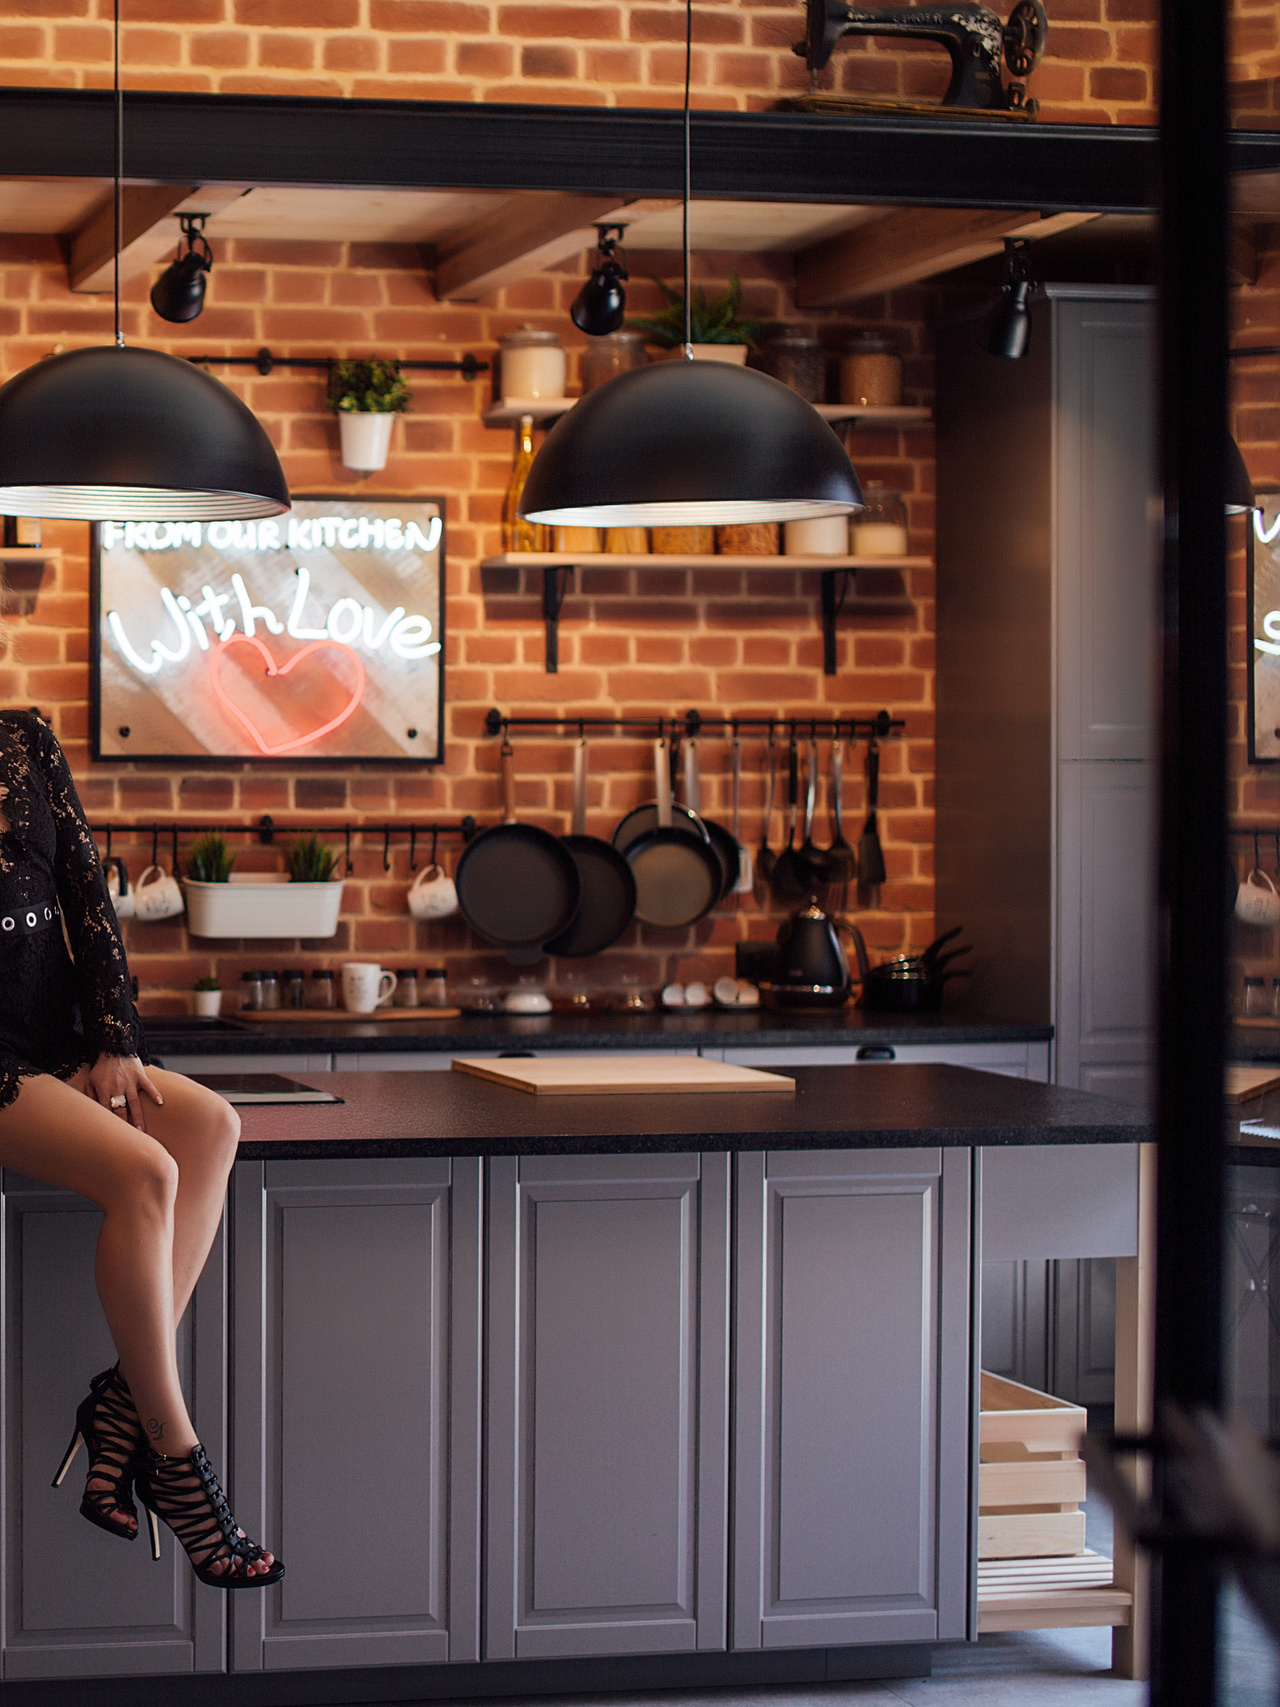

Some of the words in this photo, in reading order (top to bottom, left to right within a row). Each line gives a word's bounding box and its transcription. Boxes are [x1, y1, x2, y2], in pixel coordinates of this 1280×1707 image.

[104, 521, 202, 550] FROM
[207, 520, 281, 550] OUR
[287, 517, 442, 552] KITCHEN
[107, 574, 284, 673] With
[287, 567, 442, 660] Love
